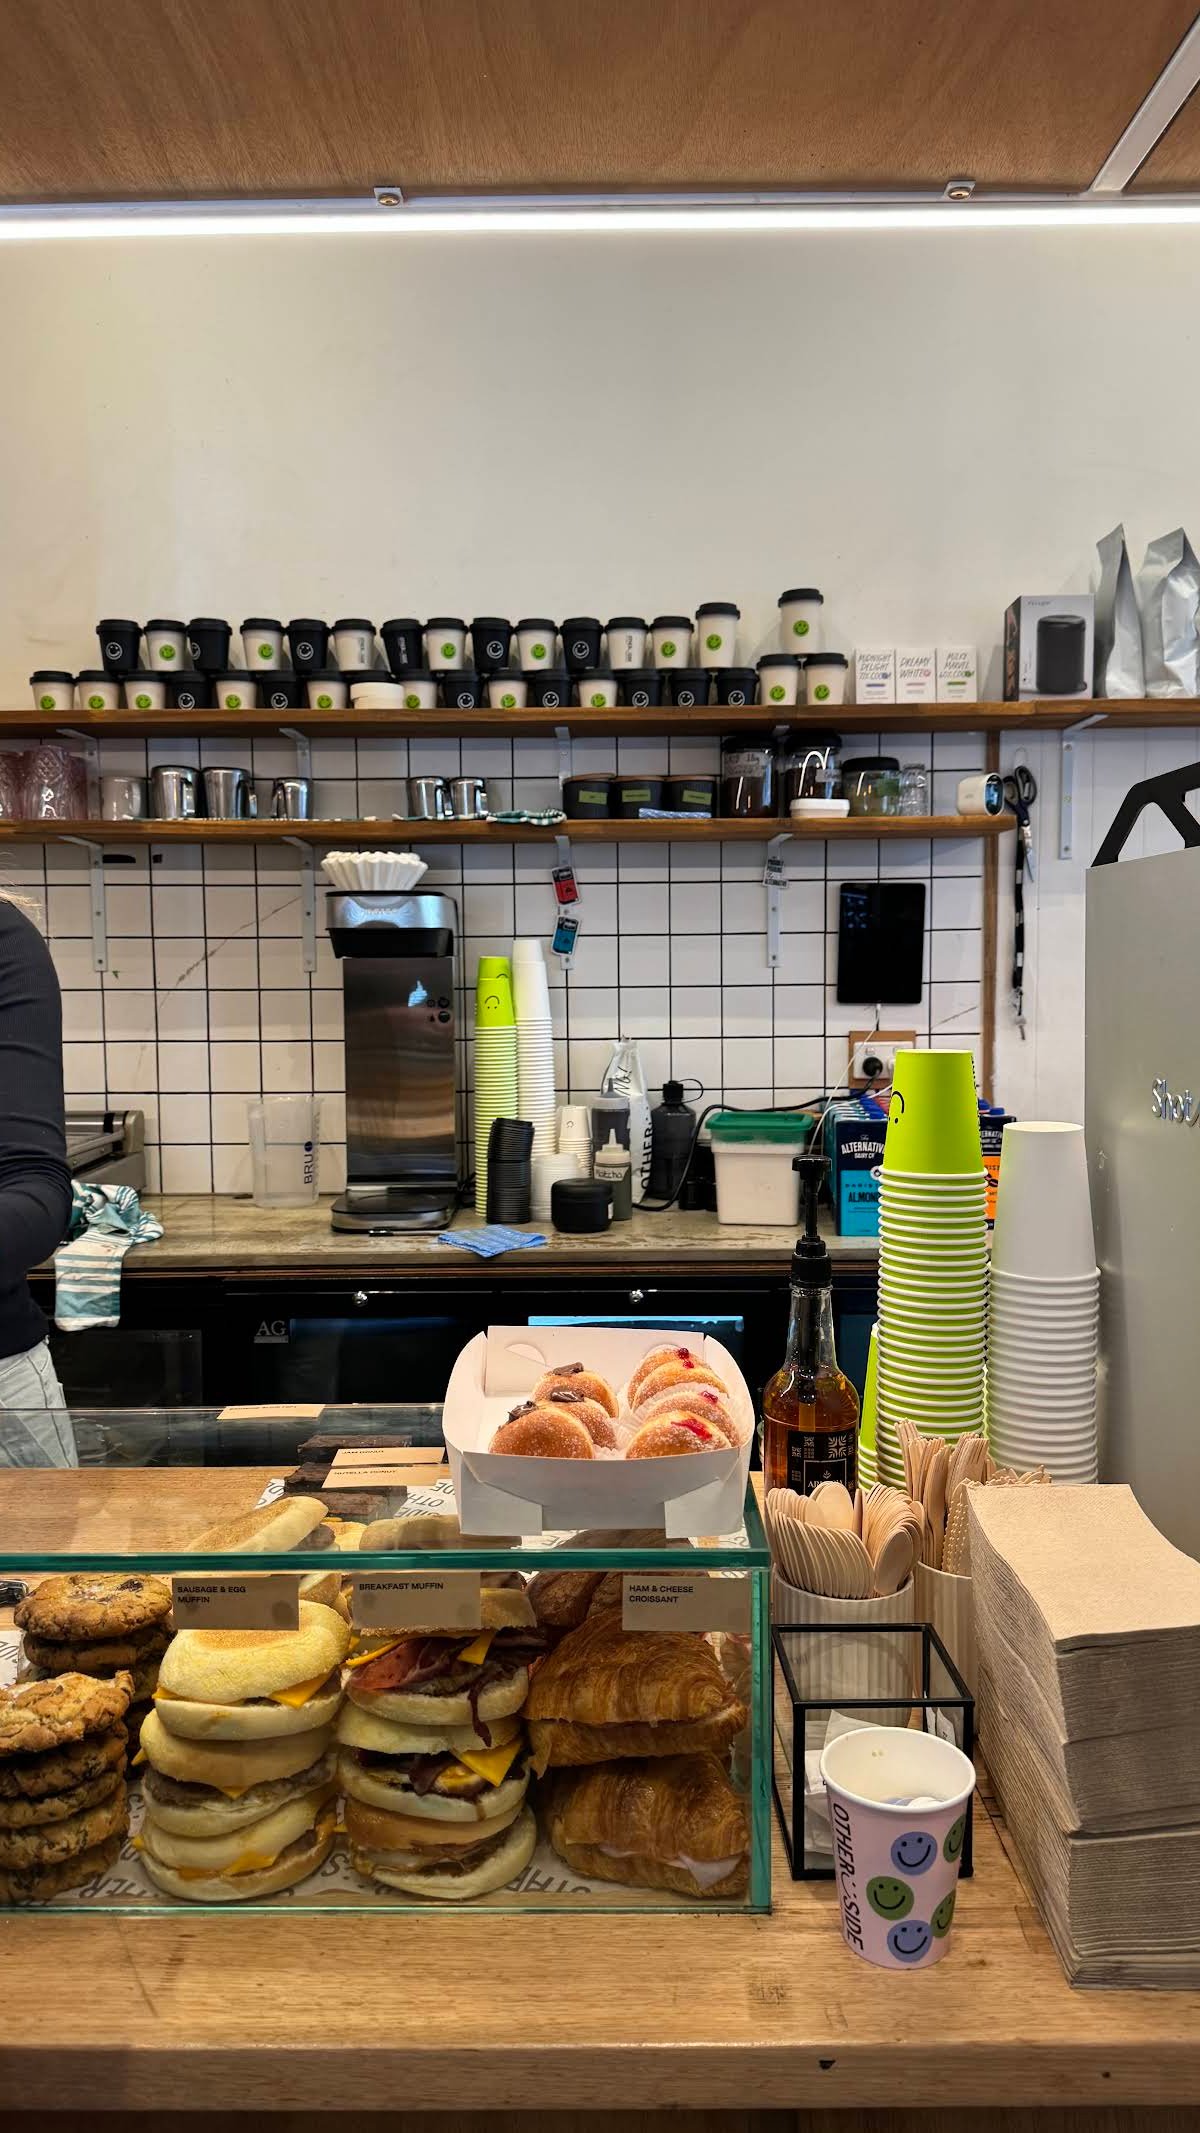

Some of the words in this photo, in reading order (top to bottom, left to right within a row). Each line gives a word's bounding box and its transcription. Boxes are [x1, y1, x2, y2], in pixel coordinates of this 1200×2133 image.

[1152, 1078, 1200, 1127] Shot
[841, 1142, 885, 1154] ALTERNATIV
[255, 1320, 286, 1336] AG
[177, 1586, 218, 1594] SAUSAGE
[358, 1582, 409, 1591] BREAKFAST
[411, 1582, 444, 1590] MUFFIN
[659, 1585, 694, 1593] CHEESE
[629, 1595, 679, 1603] CROISSANT
[833, 1802, 855, 1878] OTHER
[841, 1900, 864, 1951] SIDE
